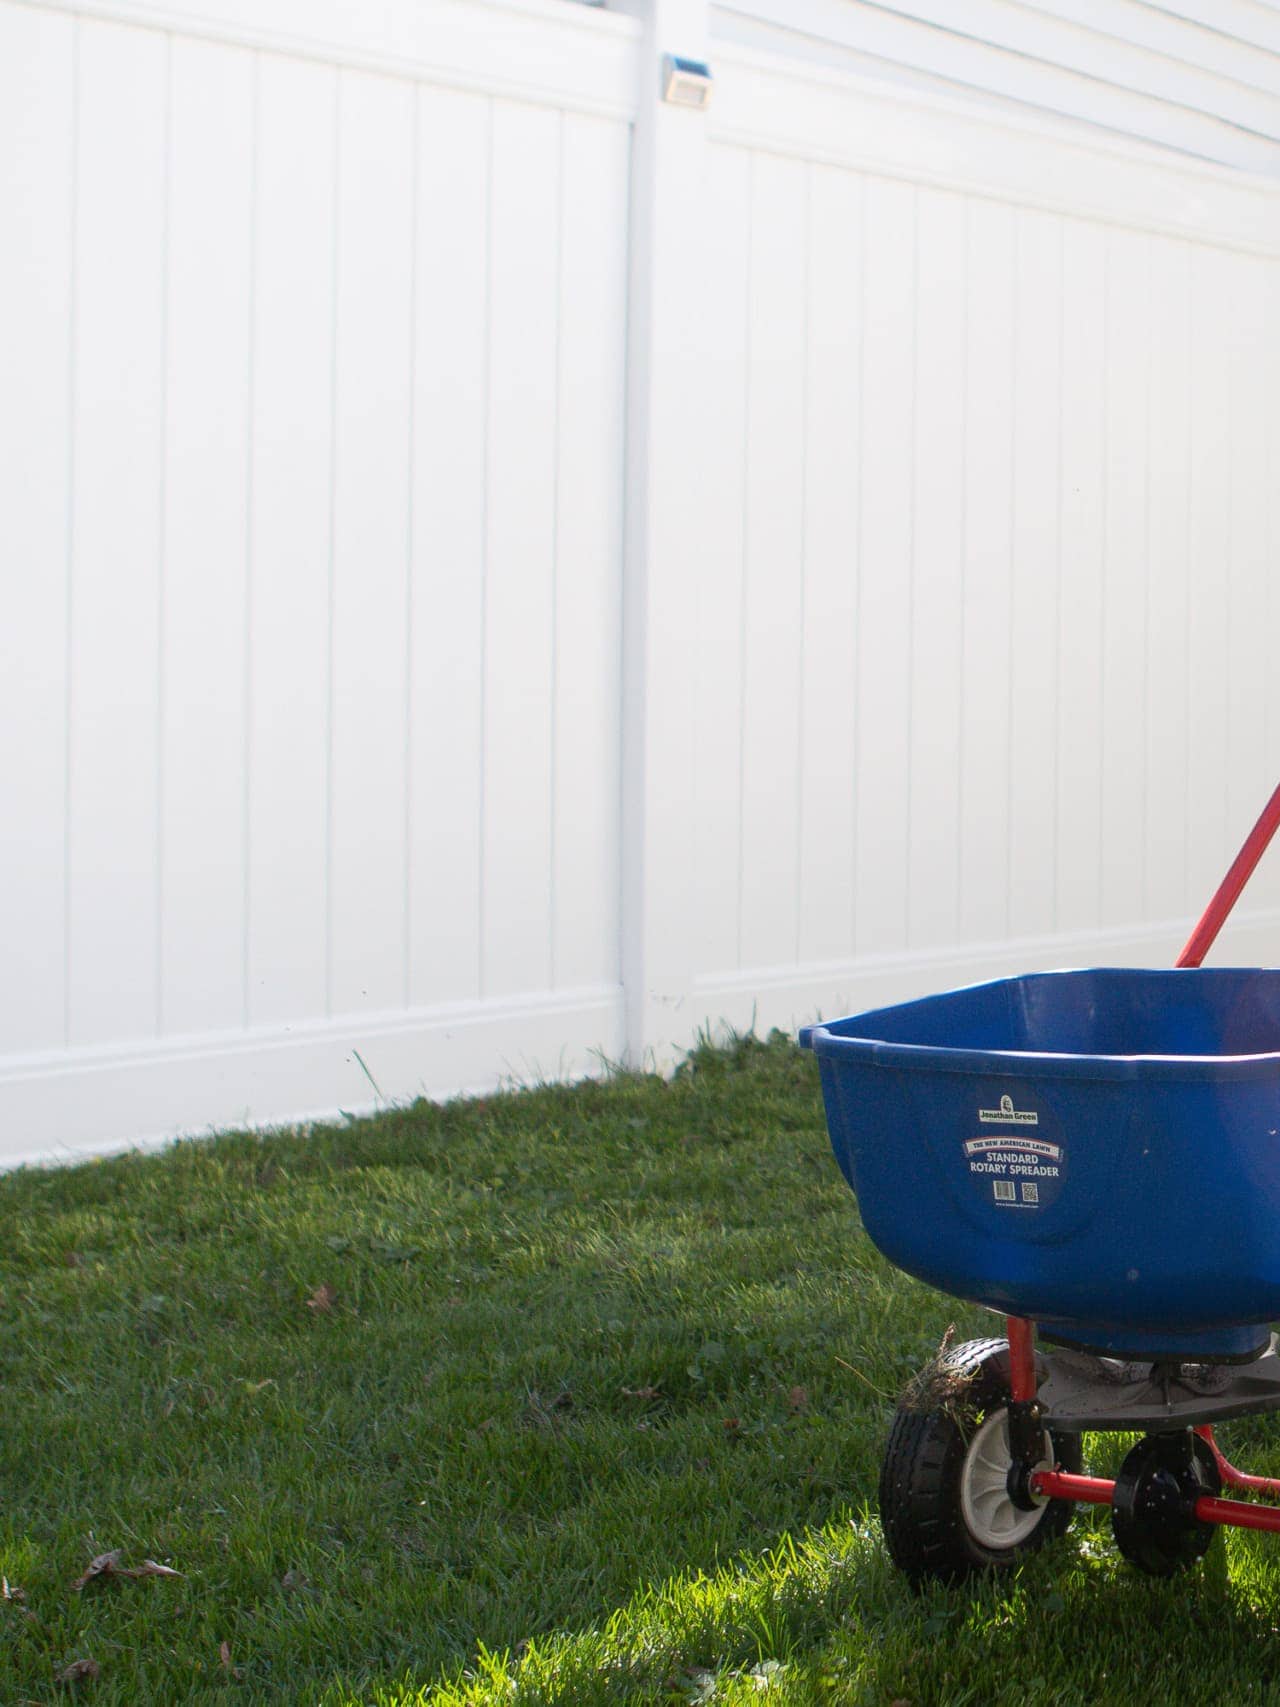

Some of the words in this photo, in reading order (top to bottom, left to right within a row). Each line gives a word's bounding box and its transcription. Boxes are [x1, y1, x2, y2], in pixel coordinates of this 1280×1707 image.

[981, 1111, 1013, 1120] Jonathan
[1014, 1112, 1037, 1121] Green
[985, 1140, 998, 1148] NEW
[999, 1140, 1031, 1149] AMERICAN
[1032, 1144, 1051, 1152] LAWN
[986, 1152, 1039, 1164] STANDARD
[970, 1162, 1007, 1174] ROTARY
[1009, 1165, 1059, 1177] SPREADER
